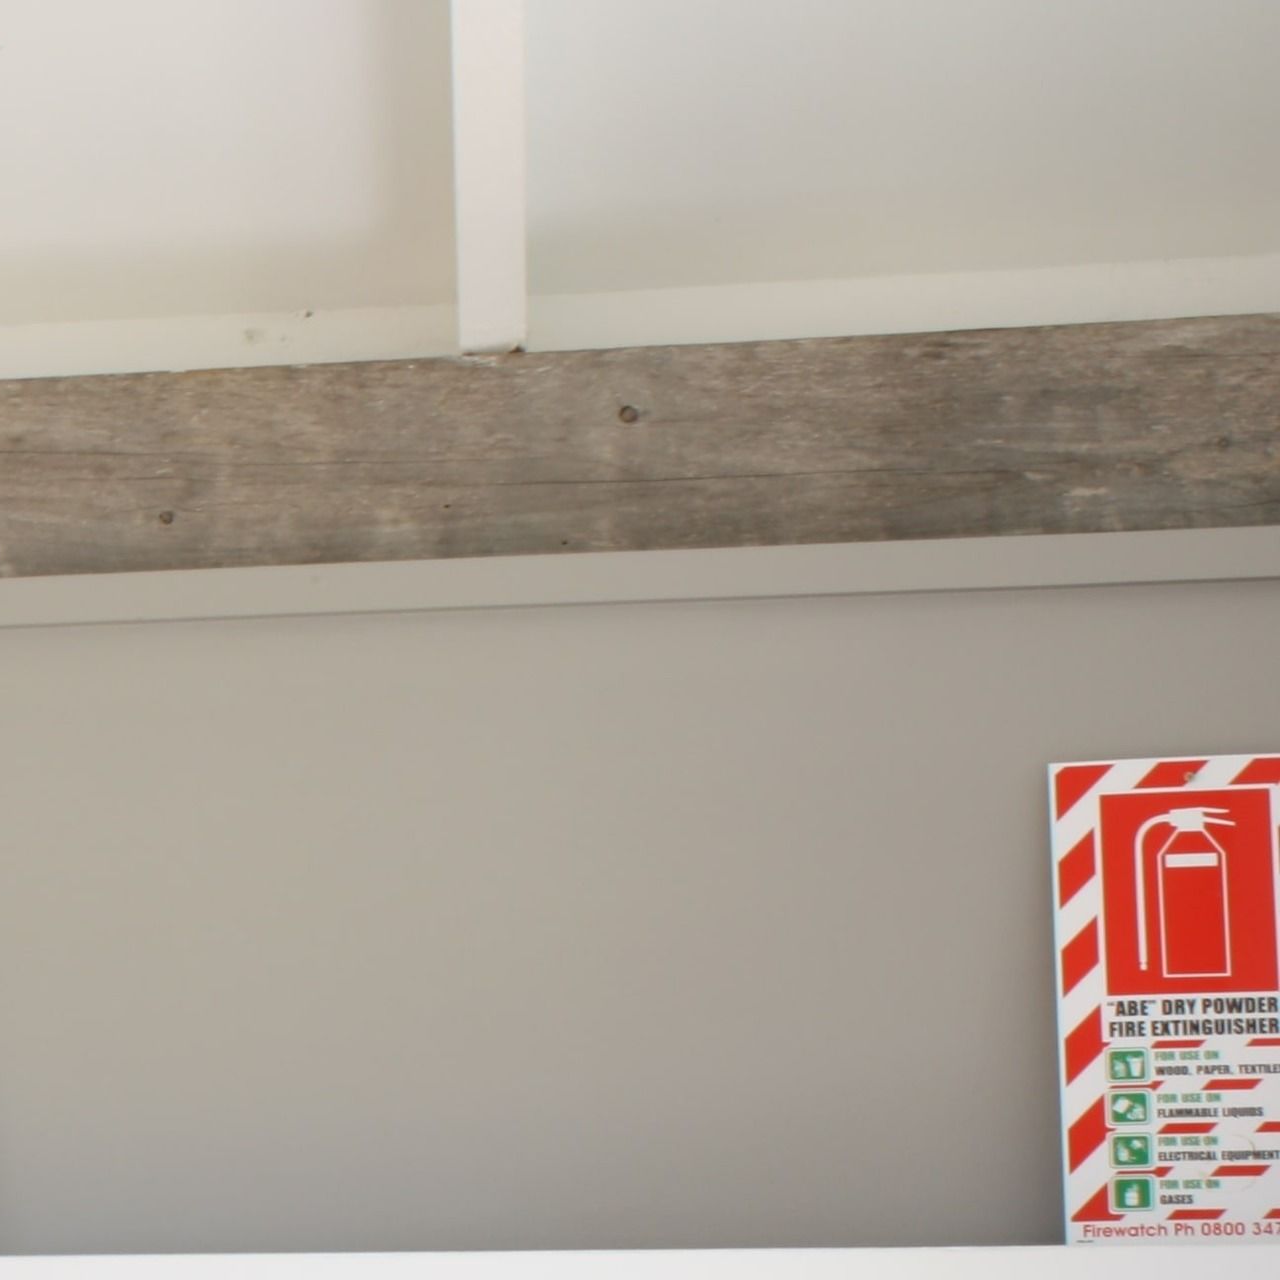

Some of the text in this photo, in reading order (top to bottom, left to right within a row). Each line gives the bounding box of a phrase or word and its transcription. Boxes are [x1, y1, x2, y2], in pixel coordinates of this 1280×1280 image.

[1162, 999, 1196, 1015] DRY
[1202, 997, 1278, 1014] POWDER
[1109, 1018, 1280, 1037] FIRE EXTINGUISHER
[1155, 1050, 1219, 1061] FOR USE ON
[1157, 1093, 1221, 1103] FOR USE ON
[1157, 1107, 1264, 1118] FLAMMABLE LIQUIDS
[1158, 1136, 1218, 1146] FOR USE ON
[1158, 1150, 1280, 1161] ELECTRICAL EQUIPMENT
[1160, 1179, 1220, 1189] FOR USE ON
[1160, 1195, 1194, 1205] GASES
[1083, 1224, 1168, 1238] Firewatch
[1174, 1223, 1195, 1236] Ph
[1201, 1222, 1246, 1236] 0800
